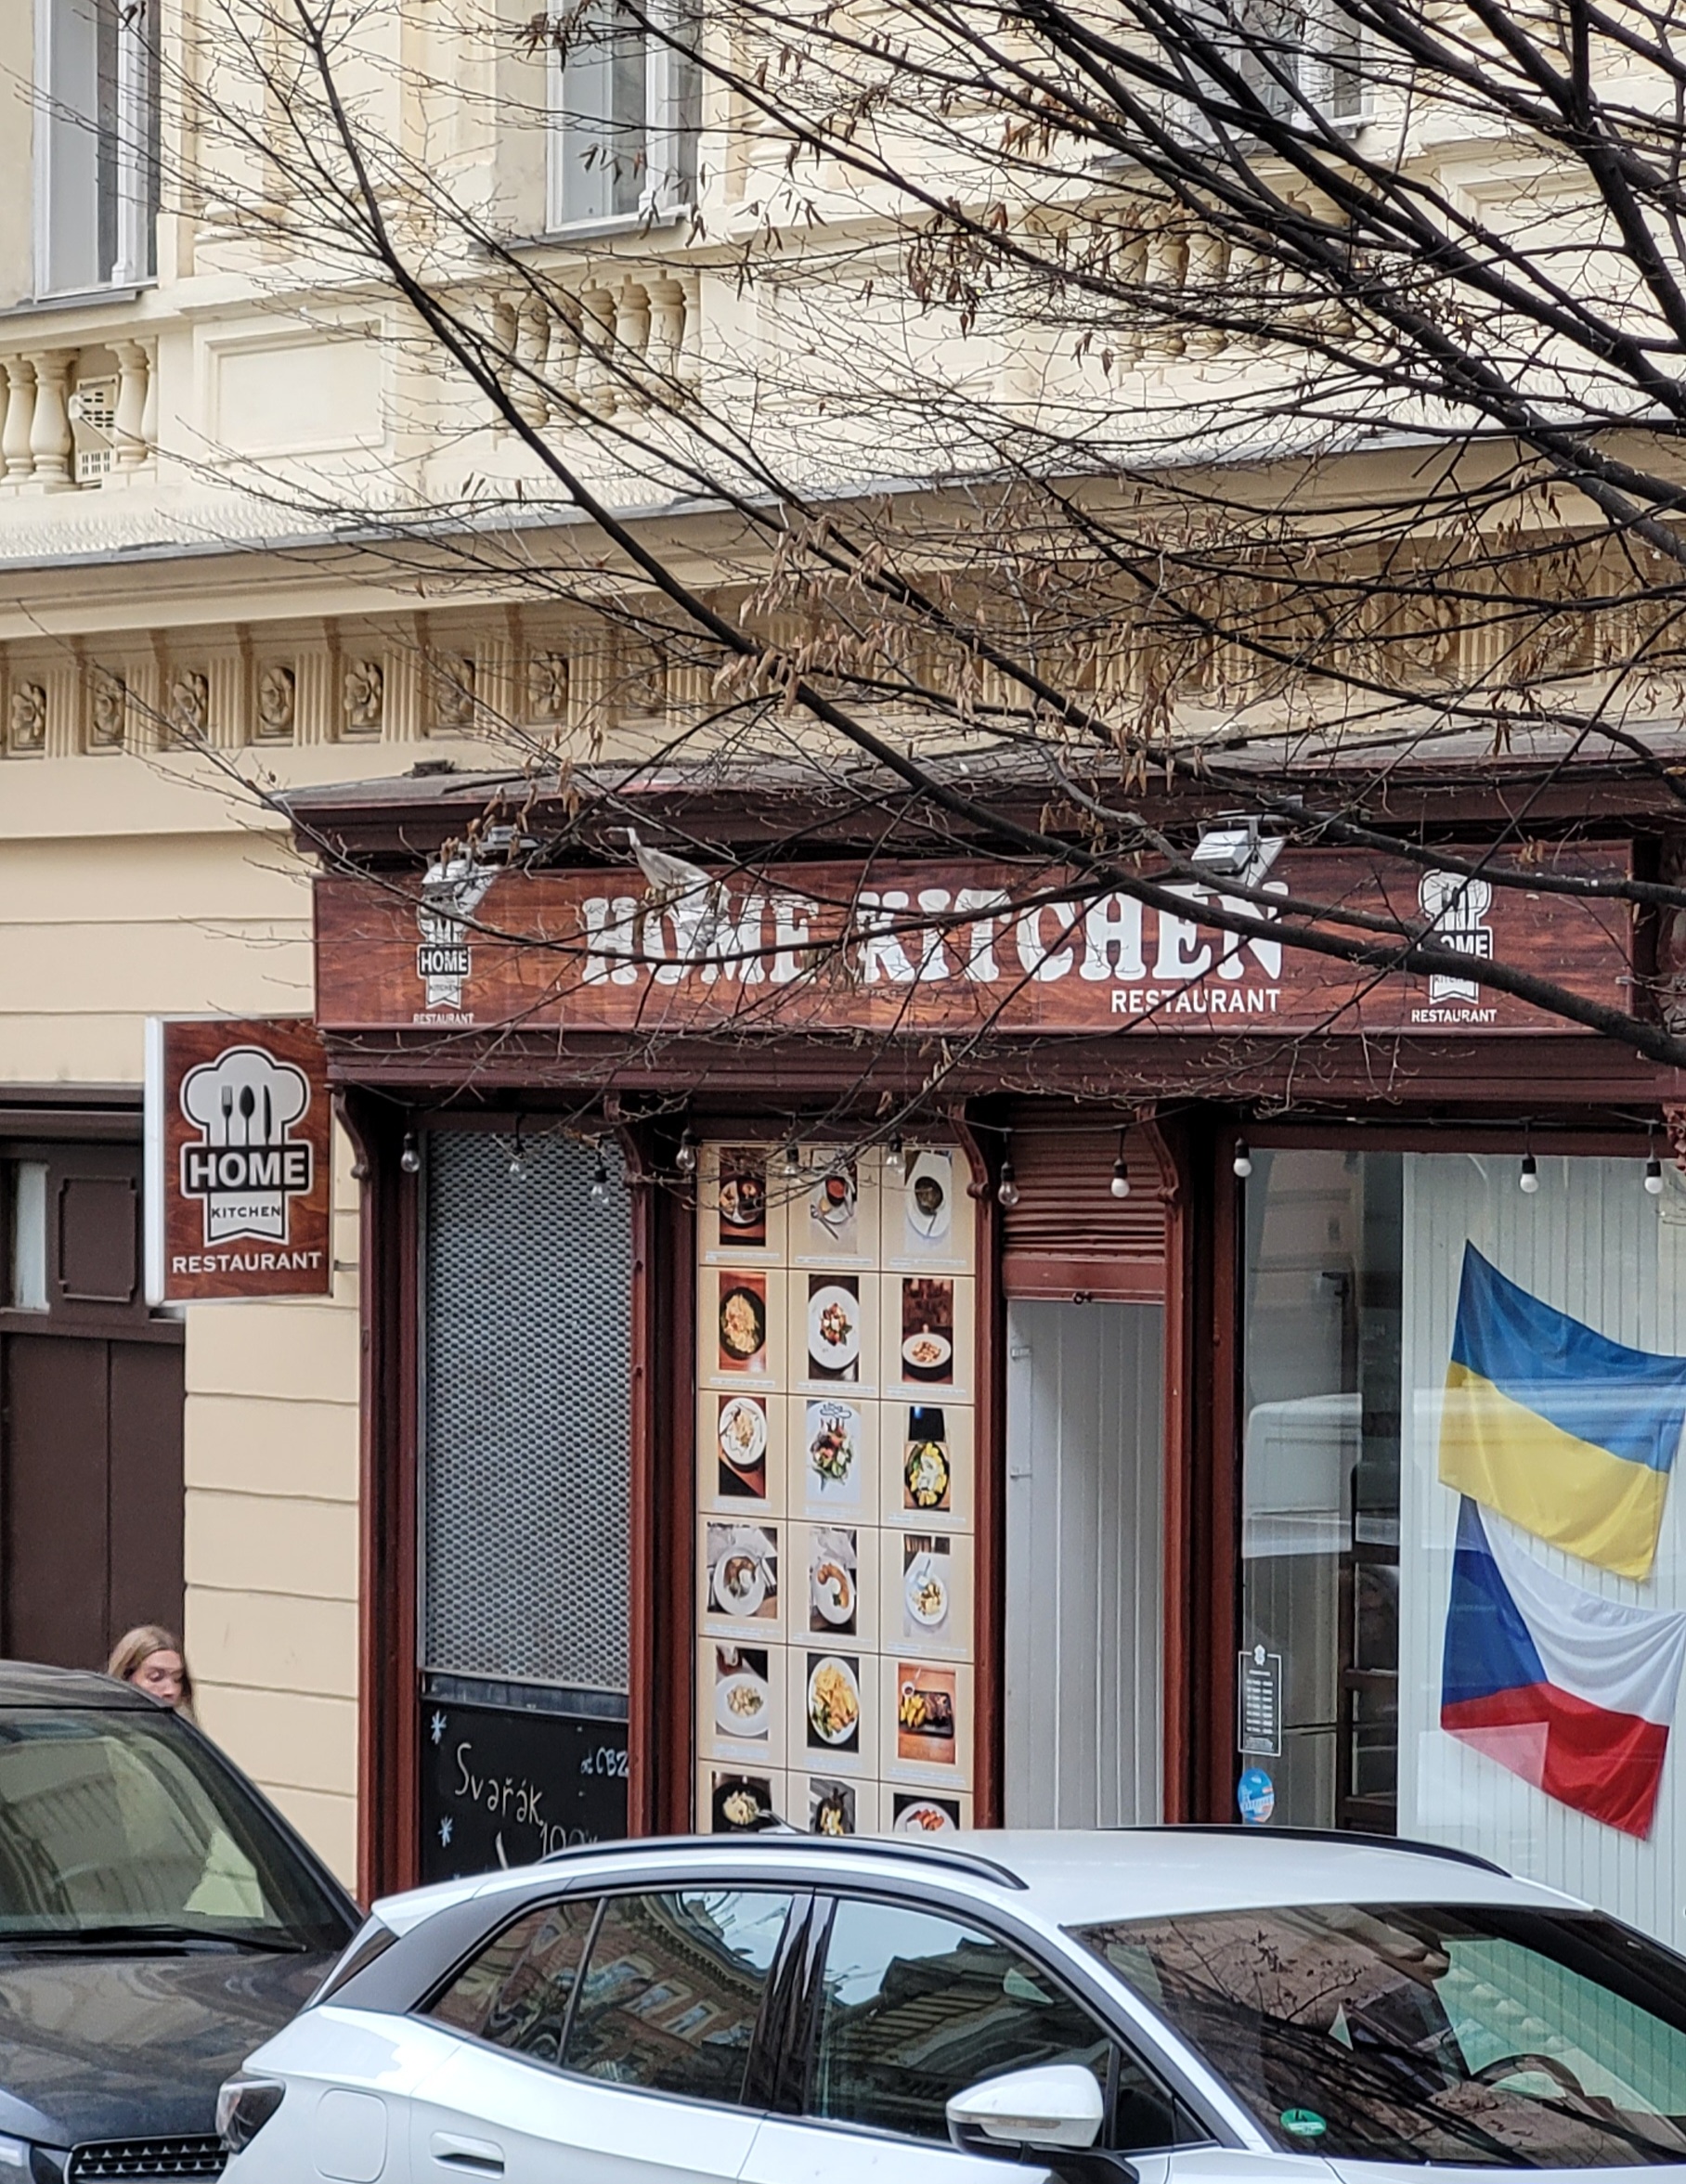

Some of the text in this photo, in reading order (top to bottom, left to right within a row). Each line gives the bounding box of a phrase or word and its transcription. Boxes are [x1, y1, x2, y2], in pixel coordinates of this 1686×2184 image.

[857, 881, 1289, 983] KITCHEN
[1440, 935, 1487, 959] ME
[421, 950, 467, 972] HOME
[1110, 988, 1281, 1014] RESTAURANT
[413, 1013, 474, 1025] RESTAURANT
[1411, 1008, 1498, 1023] RESTAURANT
[189, 1151, 306, 1187] HOME
[211, 1207, 280, 1219] KITCHEN
[172, 1251, 322, 1273] RESTAURANT
[455, 1742, 543, 1826] Svařák
